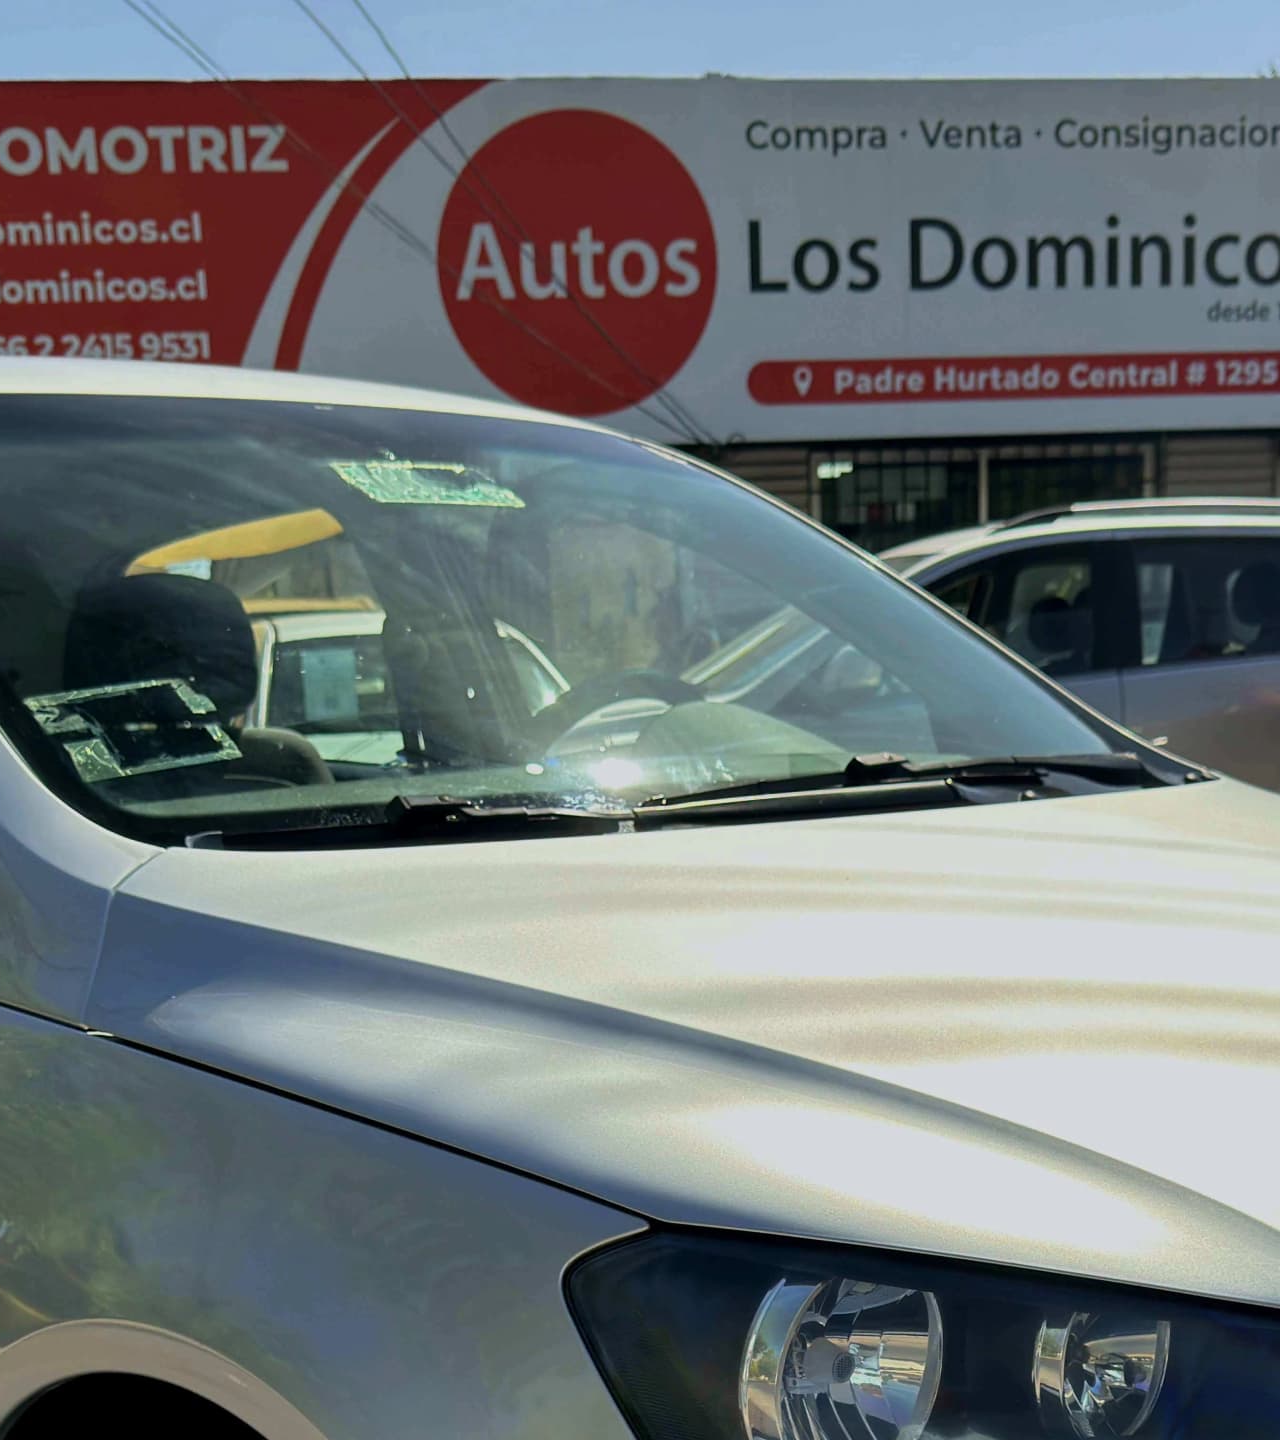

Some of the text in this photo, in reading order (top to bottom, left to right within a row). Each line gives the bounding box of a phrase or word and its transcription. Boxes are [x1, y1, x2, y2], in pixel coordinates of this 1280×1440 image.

[745, 118, 888, 155] Compra
[920, 119, 1023, 151] Venta
[457, 222, 701, 301] Autos
[747, 217, 882, 295] Los
[1207, 301, 1271, 324] desde
[32, 333, 54, 357] 2
[60, 332, 134, 359] 2415
[139, 330, 210, 361] 9531
[833, 359, 1279, 396] Padre Hurtado Central # 1295
